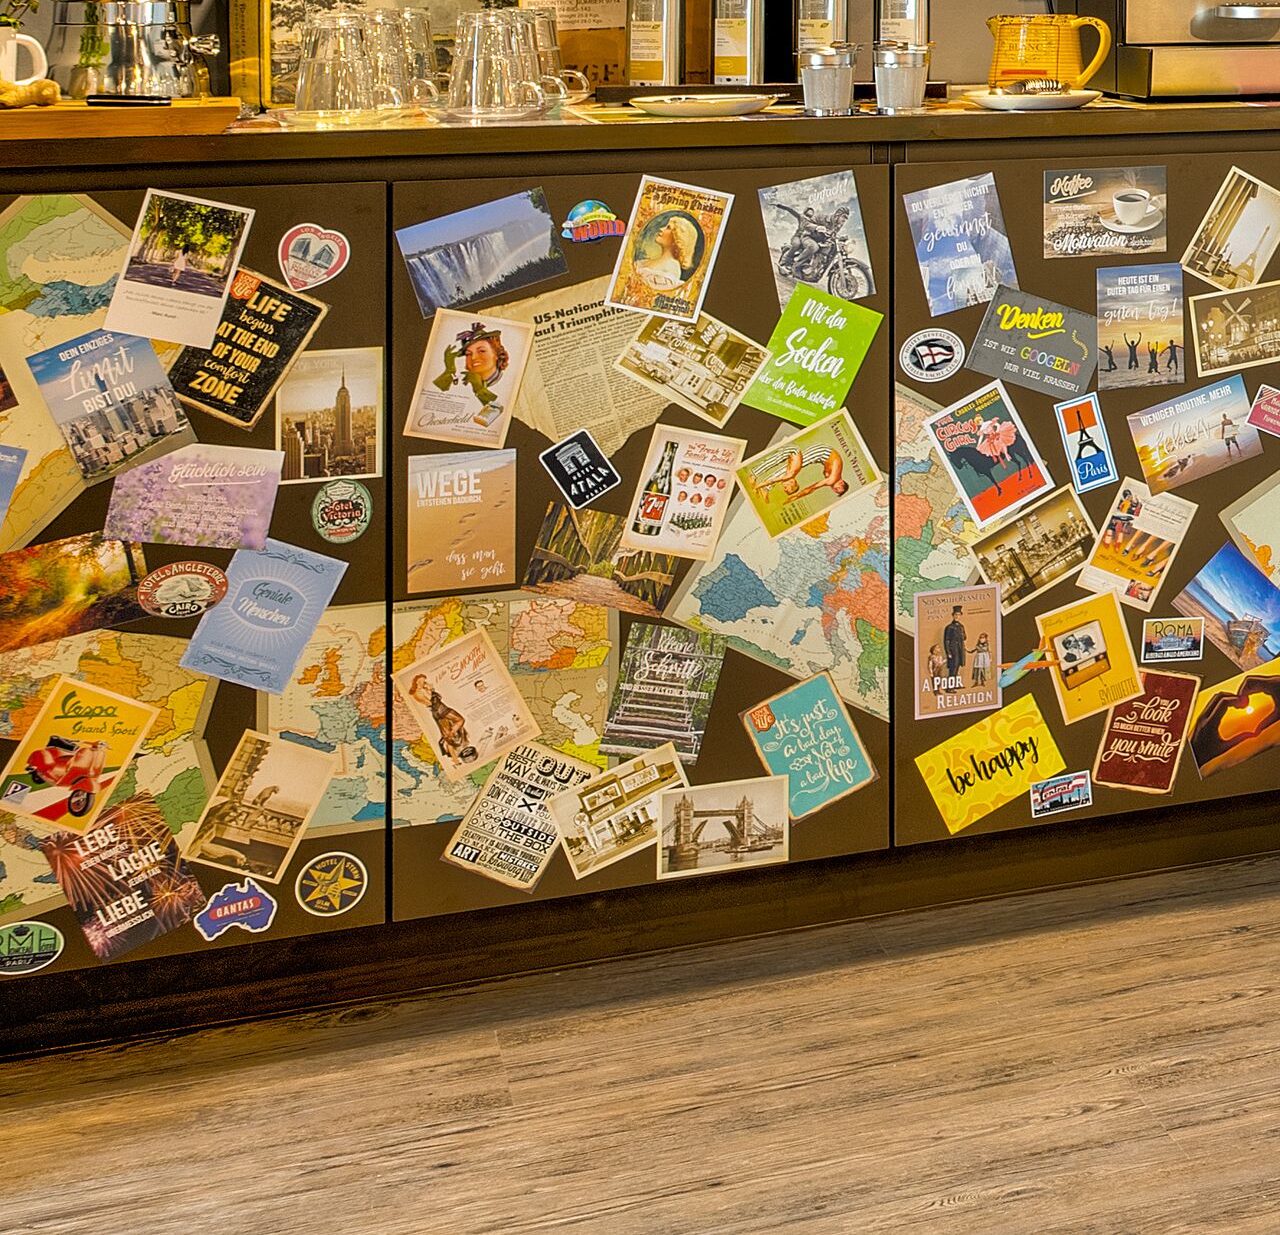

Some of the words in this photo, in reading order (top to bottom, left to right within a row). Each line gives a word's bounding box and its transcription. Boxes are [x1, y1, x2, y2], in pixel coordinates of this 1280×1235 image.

[1050, 173, 1093, 196] Kaffee
[574, 221, 624, 240] WORLD
[1053, 234, 1128, 253] Motivation
[1107, 286, 1127, 296] GUTER
[1129, 285, 1139, 295] TAG
[1141, 283, 1152, 293] FÜR
[1154, 282, 1171, 292] EINEN
[1118, 276, 1137, 286] HEUTE
[1139, 275, 1148, 284] IST
[1149, 275, 1158, 284] EIN
[247, 293, 293, 324] LIFE
[802, 299, 827, 319] Mit
[827, 311, 847, 329] den
[997, 304, 1064, 330] Denken
[1104, 308, 1140, 325] guten
[58, 347, 82, 363] DEIN
[81, 333, 115, 353] EINZIGES
[775, 331, 845, 379] Socken
[83, 393, 113, 414] BIST
[115, 383, 136, 402] DU!
[188, 371, 244, 404] ZONE
[1141, 406, 1178, 427] WENIGER
[1178, 395, 1210, 414] ROUTINE,
[1211, 385, 1232, 402] MEHR
[418, 411, 472, 431] Chesterfield
[936, 420, 977, 441] CIRCUS
[943, 434, 976, 453] GIRL
[168, 464, 235, 484] Glücklich
[238, 463, 269, 479] sein
[415, 469, 482, 498] WEGE
[570, 468, 610, 498] ATALA
[1078, 463, 1109, 483] Paris
[169, 604, 198, 613] CAIRO
[1152, 621, 1194, 638] ROMA
[922, 677, 932, 692] A
[933, 676, 964, 690] POOR
[55, 691, 118, 720] Vespa
[937, 691, 993, 709] RELATION
[773, 714, 799, 738] It's
[799, 700, 828, 732] just
[536, 756, 591, 786] OUT
[825, 759, 858, 783] life
[947, 768, 975, 796] be
[972, 735, 1040, 782] happy
[74, 824, 121, 857] LEBE
[499, 829, 522, 844] THE
[523, 838, 550, 854] BOX
[502, 820, 555, 844] OUTSIDE
[108, 841, 165, 881] LACHE
[453, 844, 479, 862] ART
[96, 890, 148, 926] LIEBE
[215, 898, 255, 917] QANTAS
